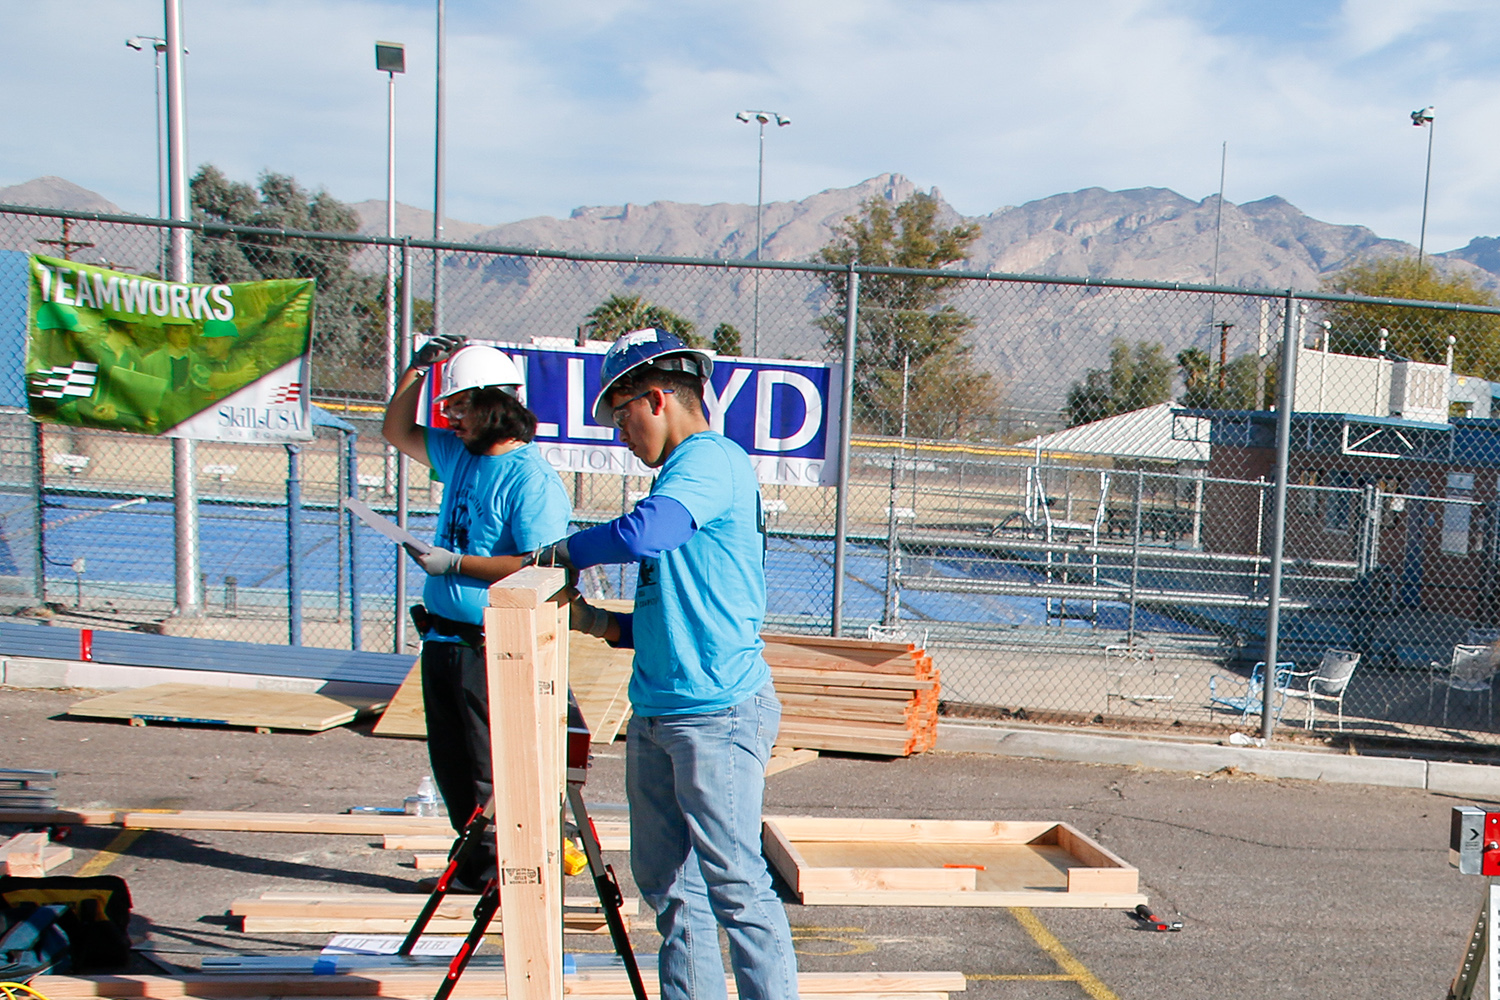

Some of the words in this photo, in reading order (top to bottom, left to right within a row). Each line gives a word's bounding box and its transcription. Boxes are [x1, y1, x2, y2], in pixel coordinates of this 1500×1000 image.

[37, 263, 235, 321] TEAMWORKS
[217, 405, 307, 432] SkillsUSA
[512, 354, 822, 452] LLYD
